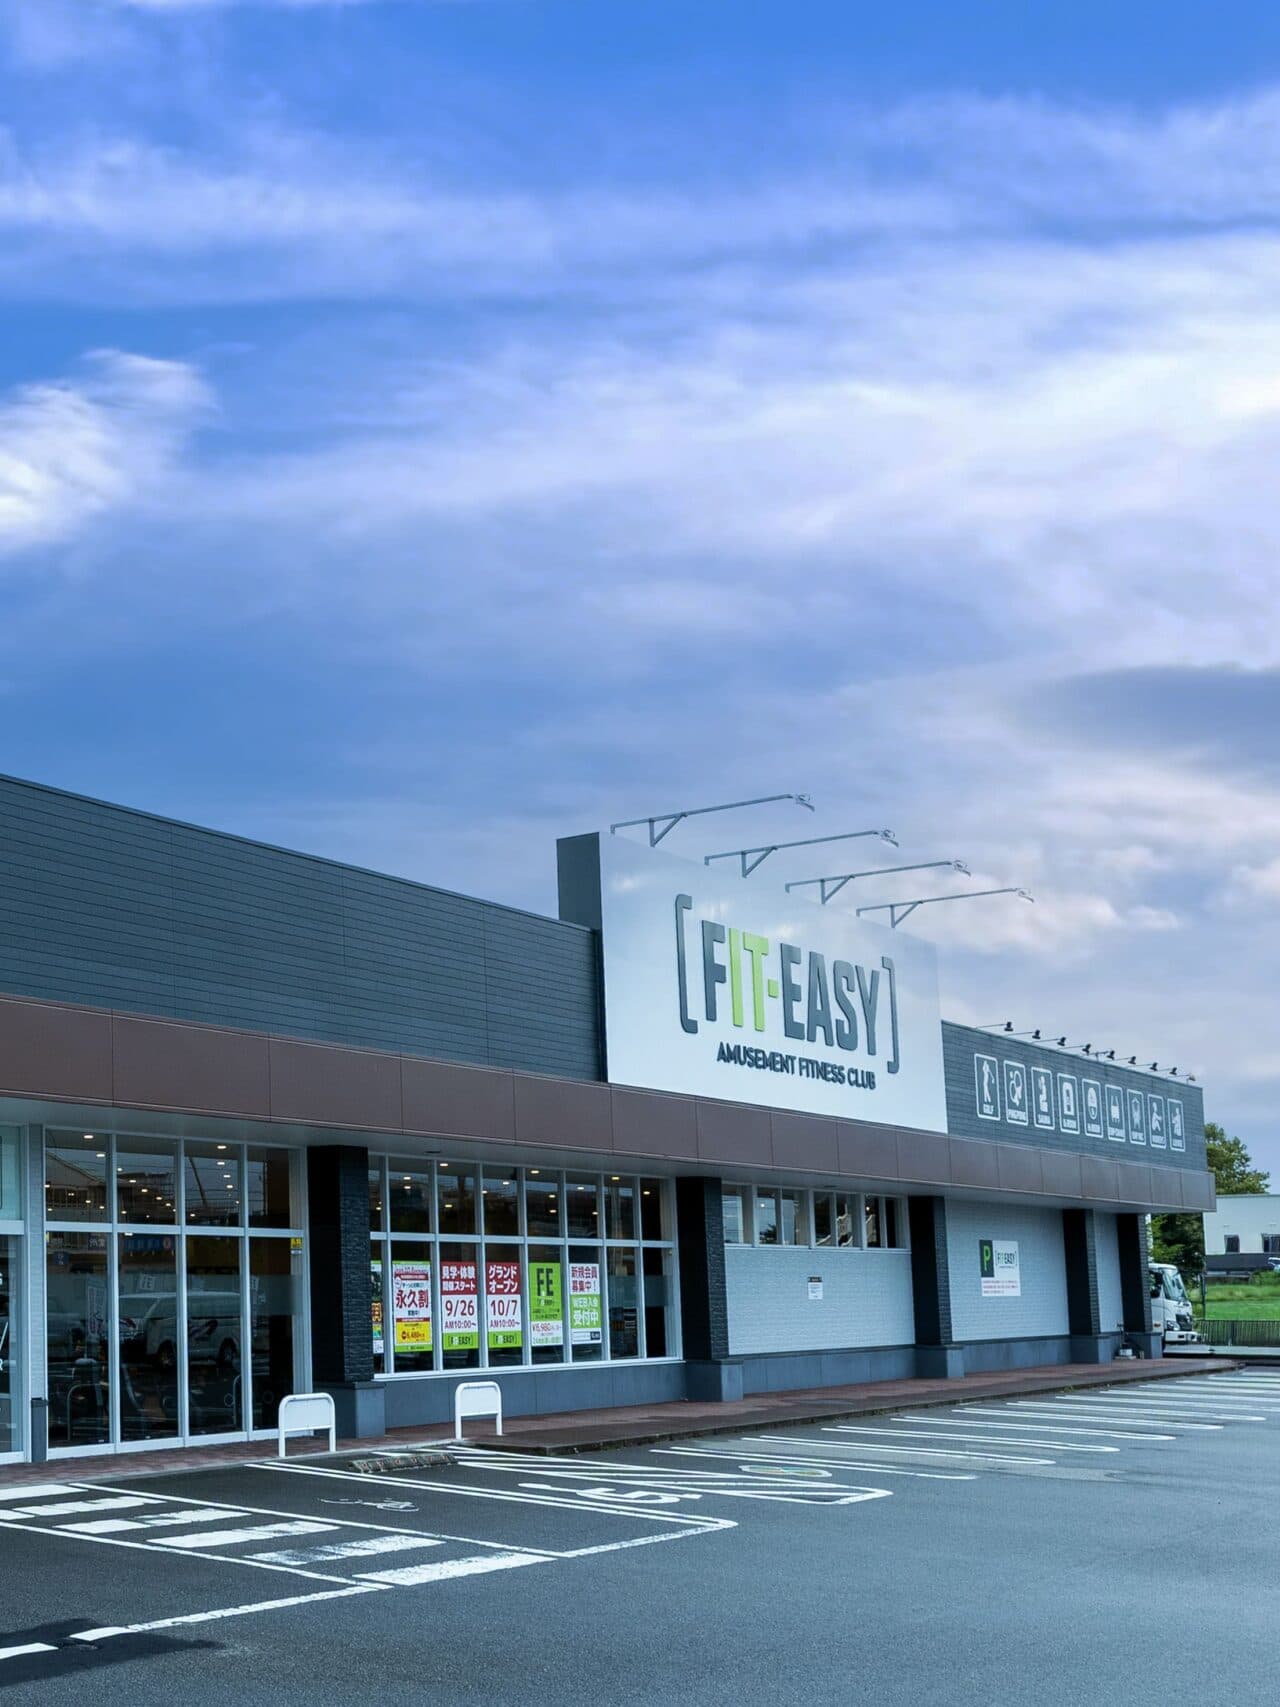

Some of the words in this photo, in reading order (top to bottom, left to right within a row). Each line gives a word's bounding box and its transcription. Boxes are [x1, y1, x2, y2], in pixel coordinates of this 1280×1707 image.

[717, 1041, 796, 1077] AMUSEMENT
[798, 1057, 846, 1085] FITNESS
[847, 1069, 876, 1090] CLUB
[983, 1245, 991, 1271] P
[488, 1265, 518, 1279] グランド
[489, 1279, 518, 1293] オープン
[396, 1289, 429, 1309] 永久割
[490, 1299, 518, 1316] 10/7
[445, 1299, 475, 1317] 9/26
[574, 1309, 598, 1326] 受付中
